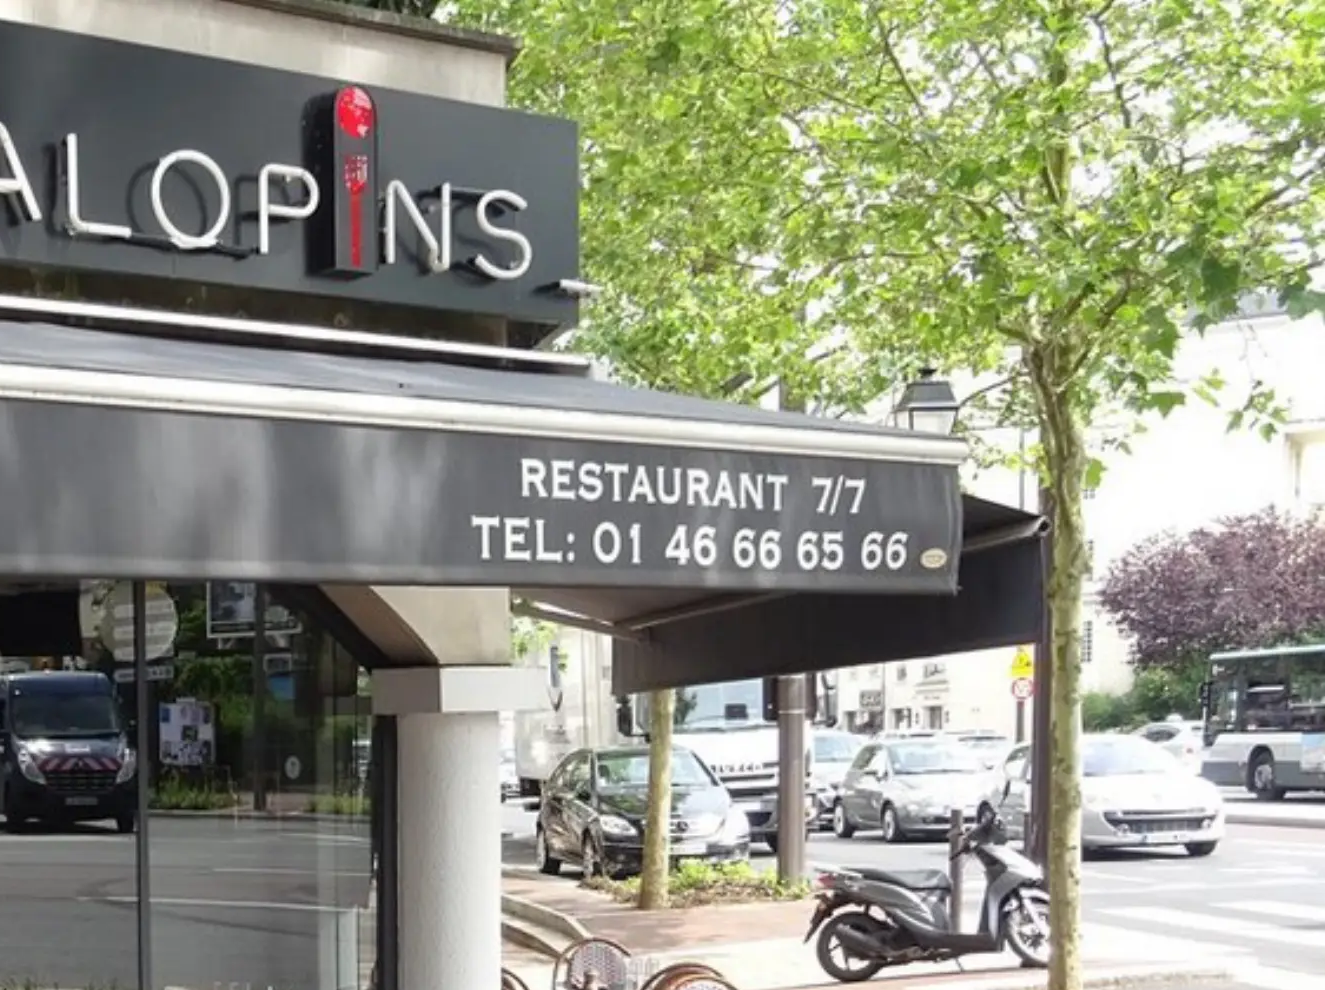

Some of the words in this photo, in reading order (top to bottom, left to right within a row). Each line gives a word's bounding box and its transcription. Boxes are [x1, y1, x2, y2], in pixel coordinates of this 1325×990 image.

[520, 458, 789, 511] RESTAURANT
[811, 475, 866, 516] 7/7
[471, 515, 576, 562] TEL:
[592, 521, 641, 564] 01
[665, 524, 717, 566] 46
[733, 528, 783, 570] 66
[797, 530, 844, 571] 65
[861, 531, 909, 570] 66
